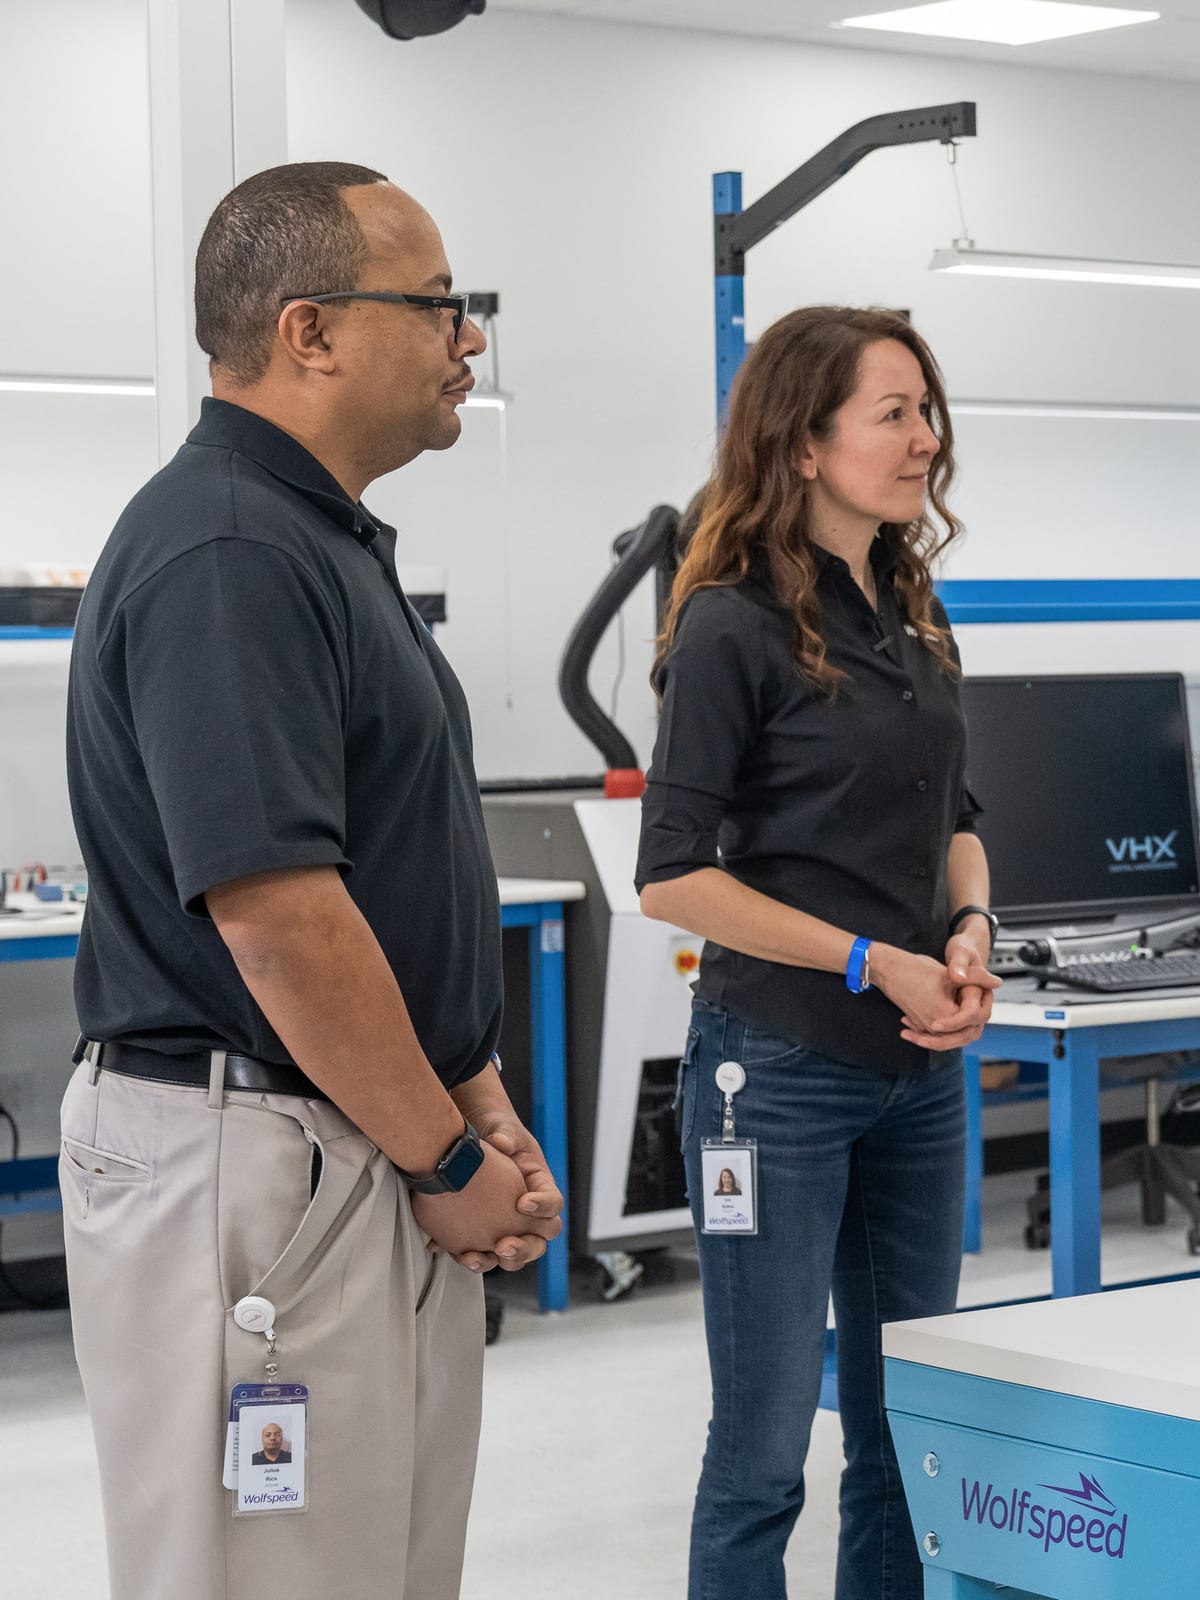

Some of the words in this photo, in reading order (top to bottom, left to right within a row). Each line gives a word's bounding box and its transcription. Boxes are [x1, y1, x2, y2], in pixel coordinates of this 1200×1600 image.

[1105, 829, 1178, 864] VHX
[244, 1491, 298, 1505] Wolfspeed
[961, 1477, 1128, 1559] Wolfspeed
